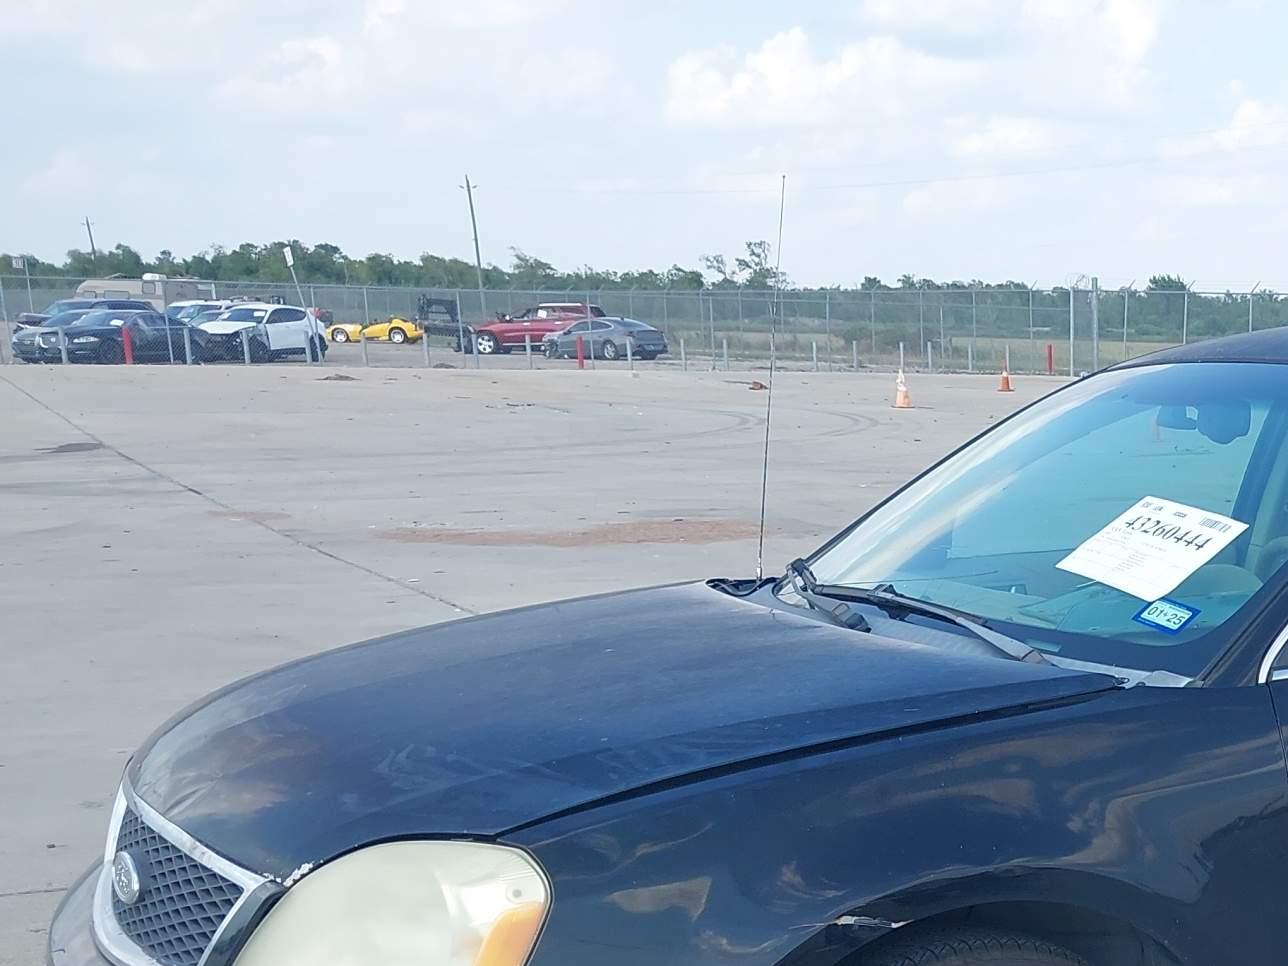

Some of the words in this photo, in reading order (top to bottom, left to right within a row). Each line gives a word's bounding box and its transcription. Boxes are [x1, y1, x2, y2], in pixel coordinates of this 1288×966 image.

[1125, 516, 1213, 551] 43260444
[1147, 606, 1165, 618] 01
[1166, 613, 1186, 626] 25
